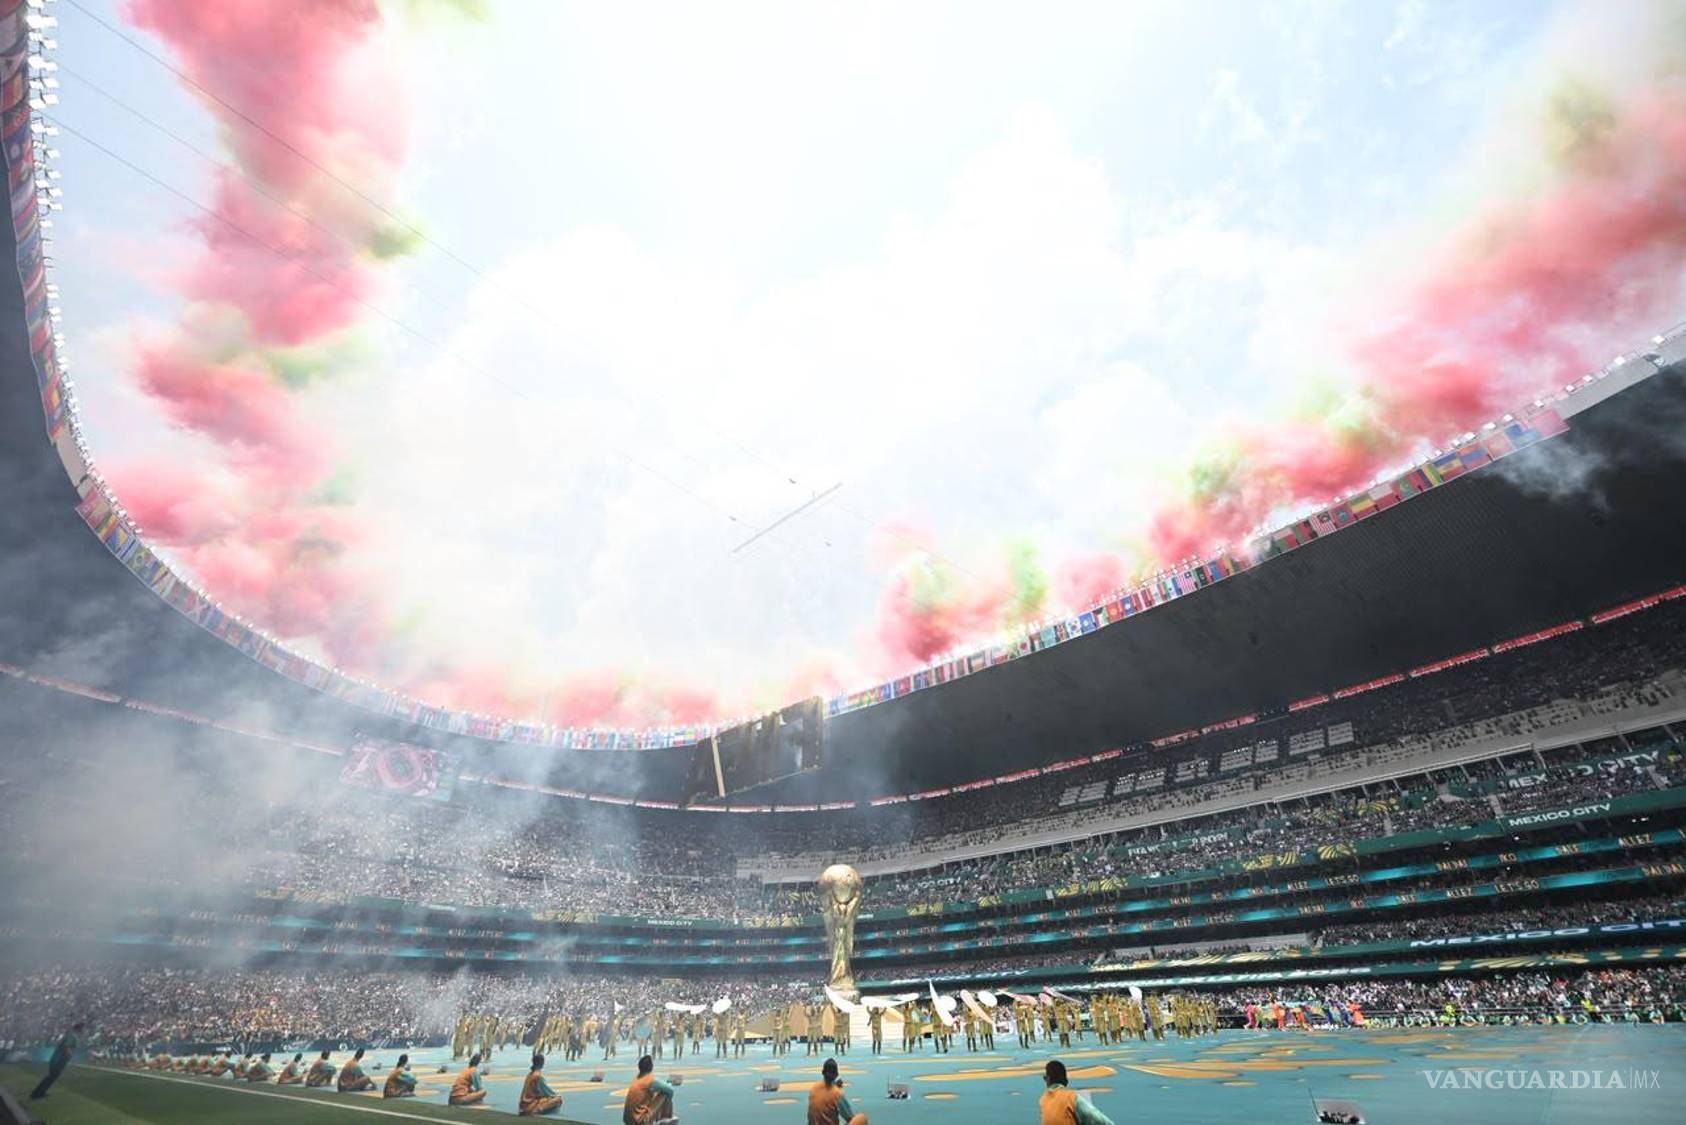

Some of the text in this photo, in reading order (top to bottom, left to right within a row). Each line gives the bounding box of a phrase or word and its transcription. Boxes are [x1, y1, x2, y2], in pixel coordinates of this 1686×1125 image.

[1508, 803, 1611, 827] MEXICO CITY
[1410, 928, 1589, 947] MEXICO
